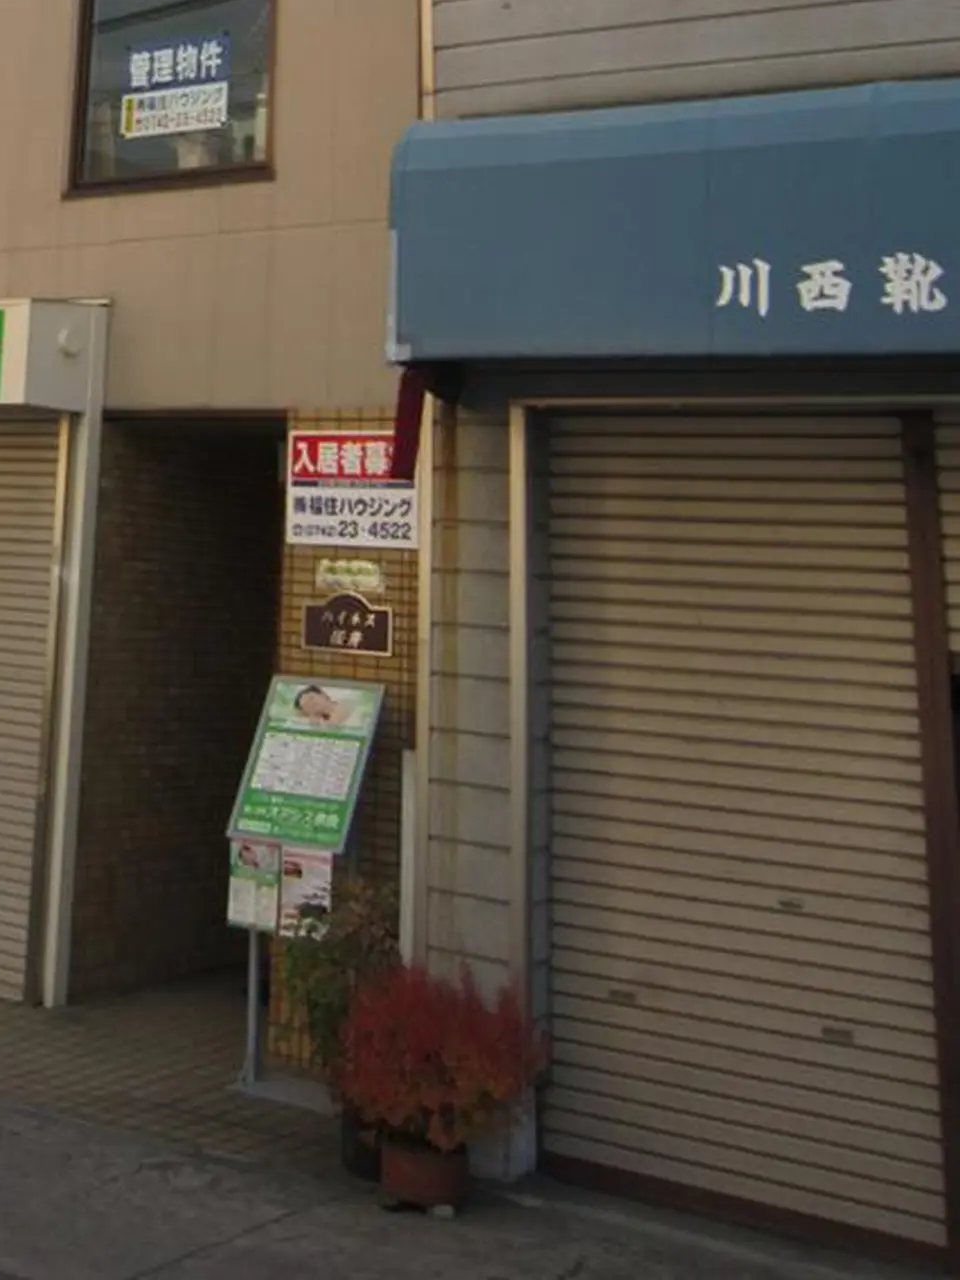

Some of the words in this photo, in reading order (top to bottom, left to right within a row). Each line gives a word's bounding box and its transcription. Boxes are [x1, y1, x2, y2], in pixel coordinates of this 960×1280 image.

[130, 40, 223, 88] 管理物件
[715, 252, 947, 316] 川西靴
[293, 441, 394, 475] 入居者募
